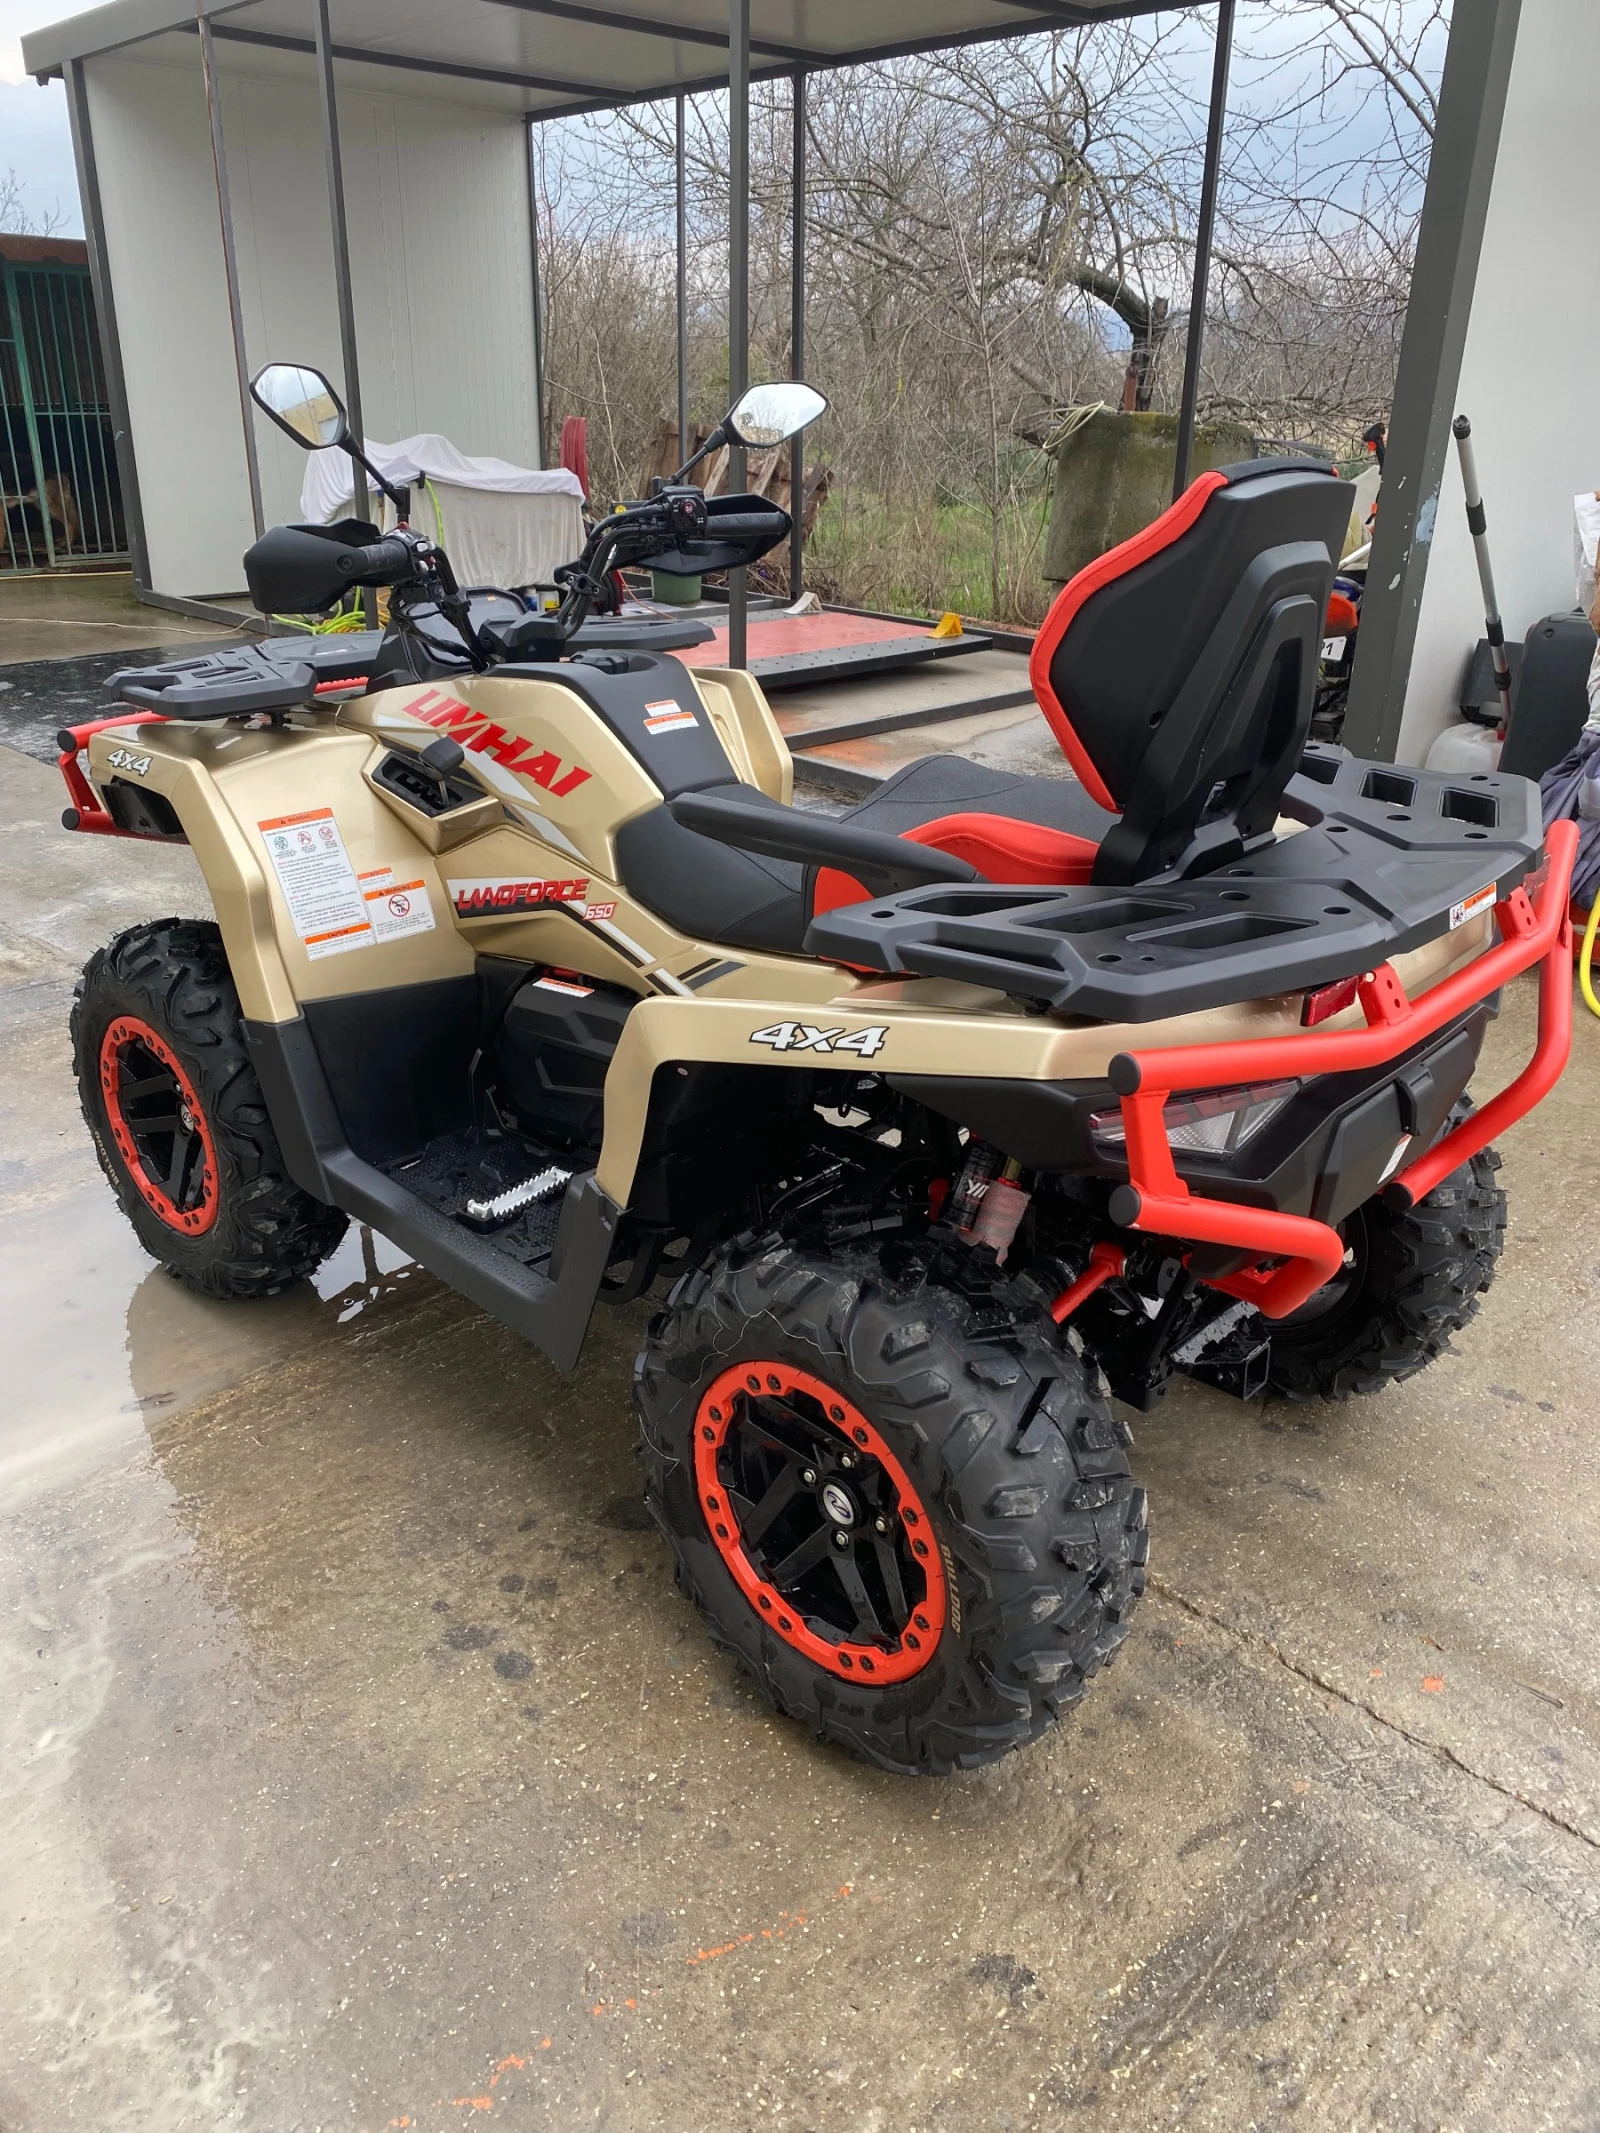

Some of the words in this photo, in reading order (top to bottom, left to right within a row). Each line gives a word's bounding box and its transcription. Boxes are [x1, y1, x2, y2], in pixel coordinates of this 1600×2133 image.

[402, 689, 593, 798] LINHAI
[384, 884, 411, 895] WARNING
[457, 878, 591, 911] LANDFORCE
[584, 903, 616, 920] 650
[327, 929, 349, 938] CAUTION
[940, 1543, 961, 1634] BULLDOG
